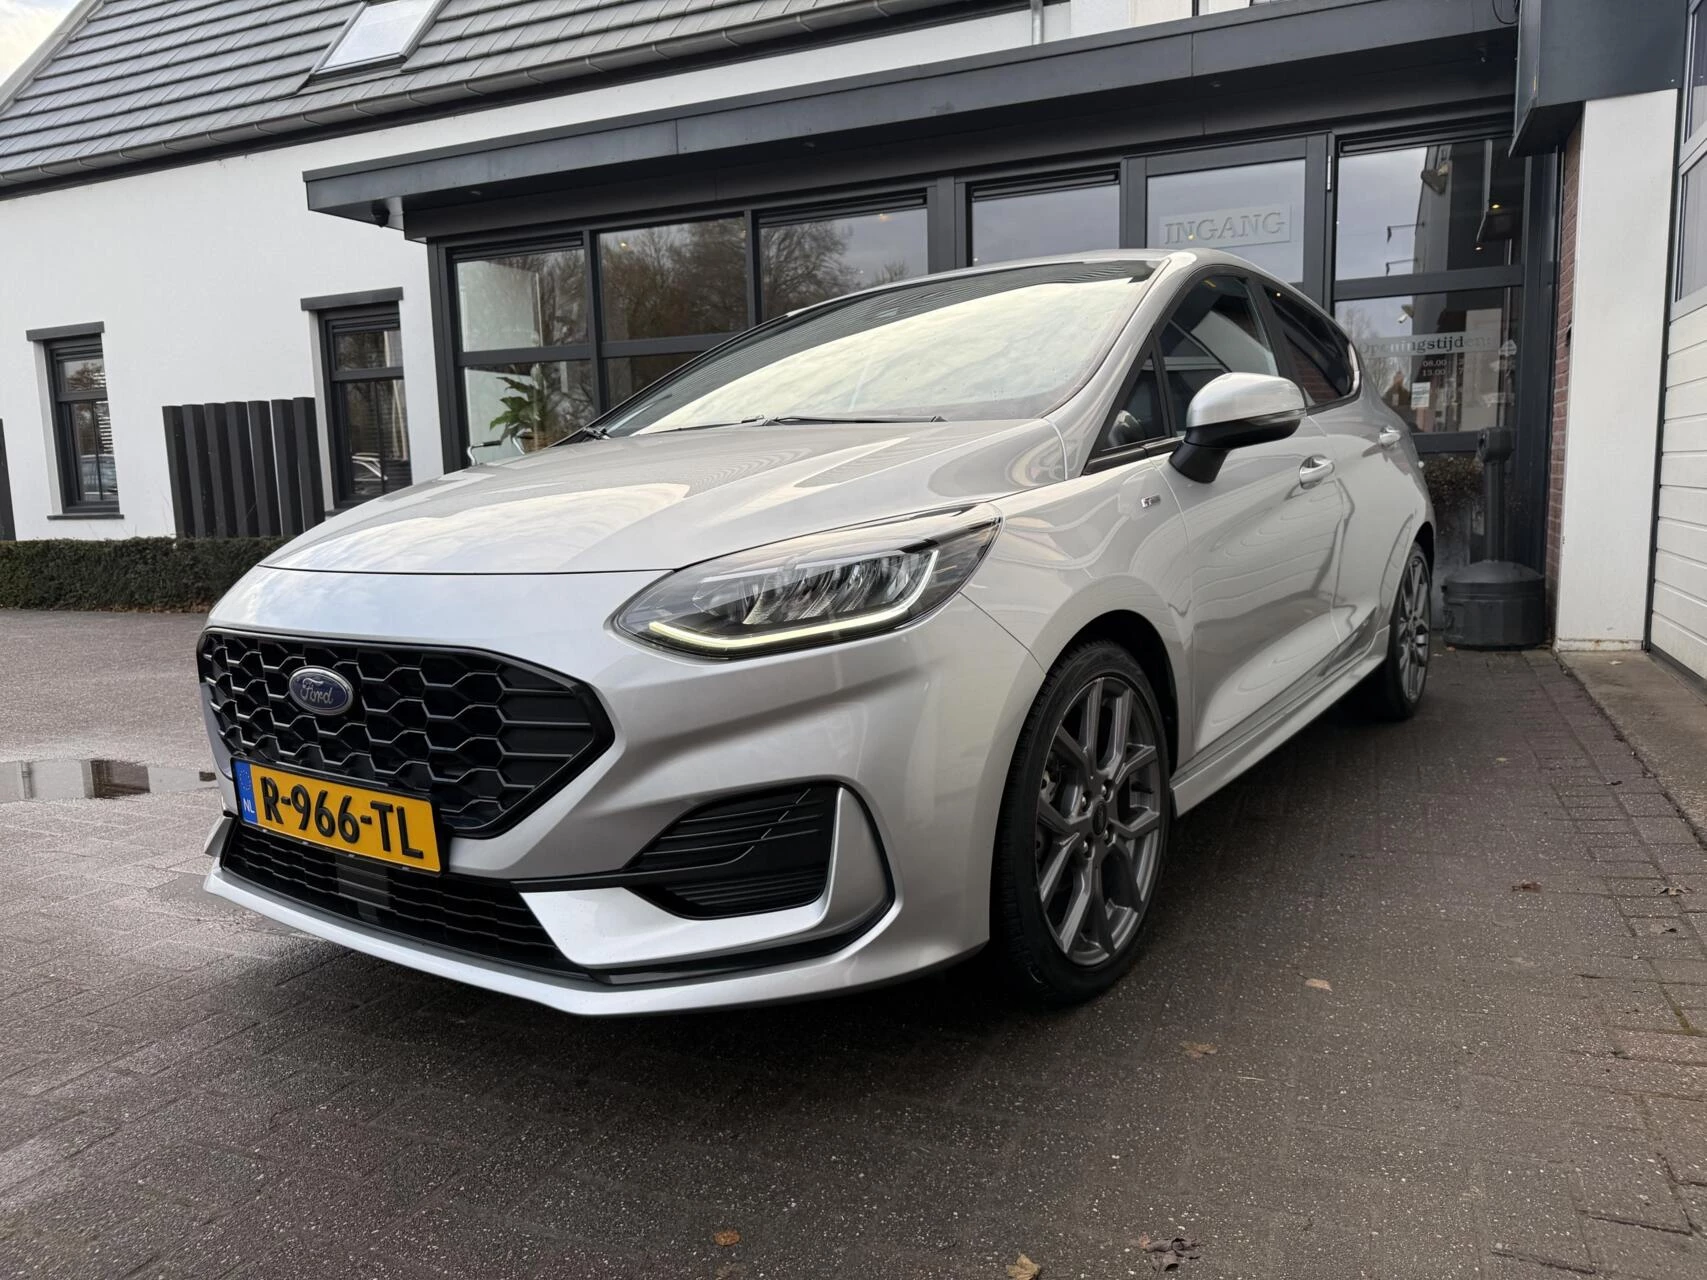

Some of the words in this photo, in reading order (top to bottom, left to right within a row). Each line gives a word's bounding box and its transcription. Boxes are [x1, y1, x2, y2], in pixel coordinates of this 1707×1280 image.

[1164, 211, 1286, 245] INGANG
[300, 677, 335, 704] Ford
[243, 797, 255, 814] NL
[259, 776, 425, 860] R-966-TL
